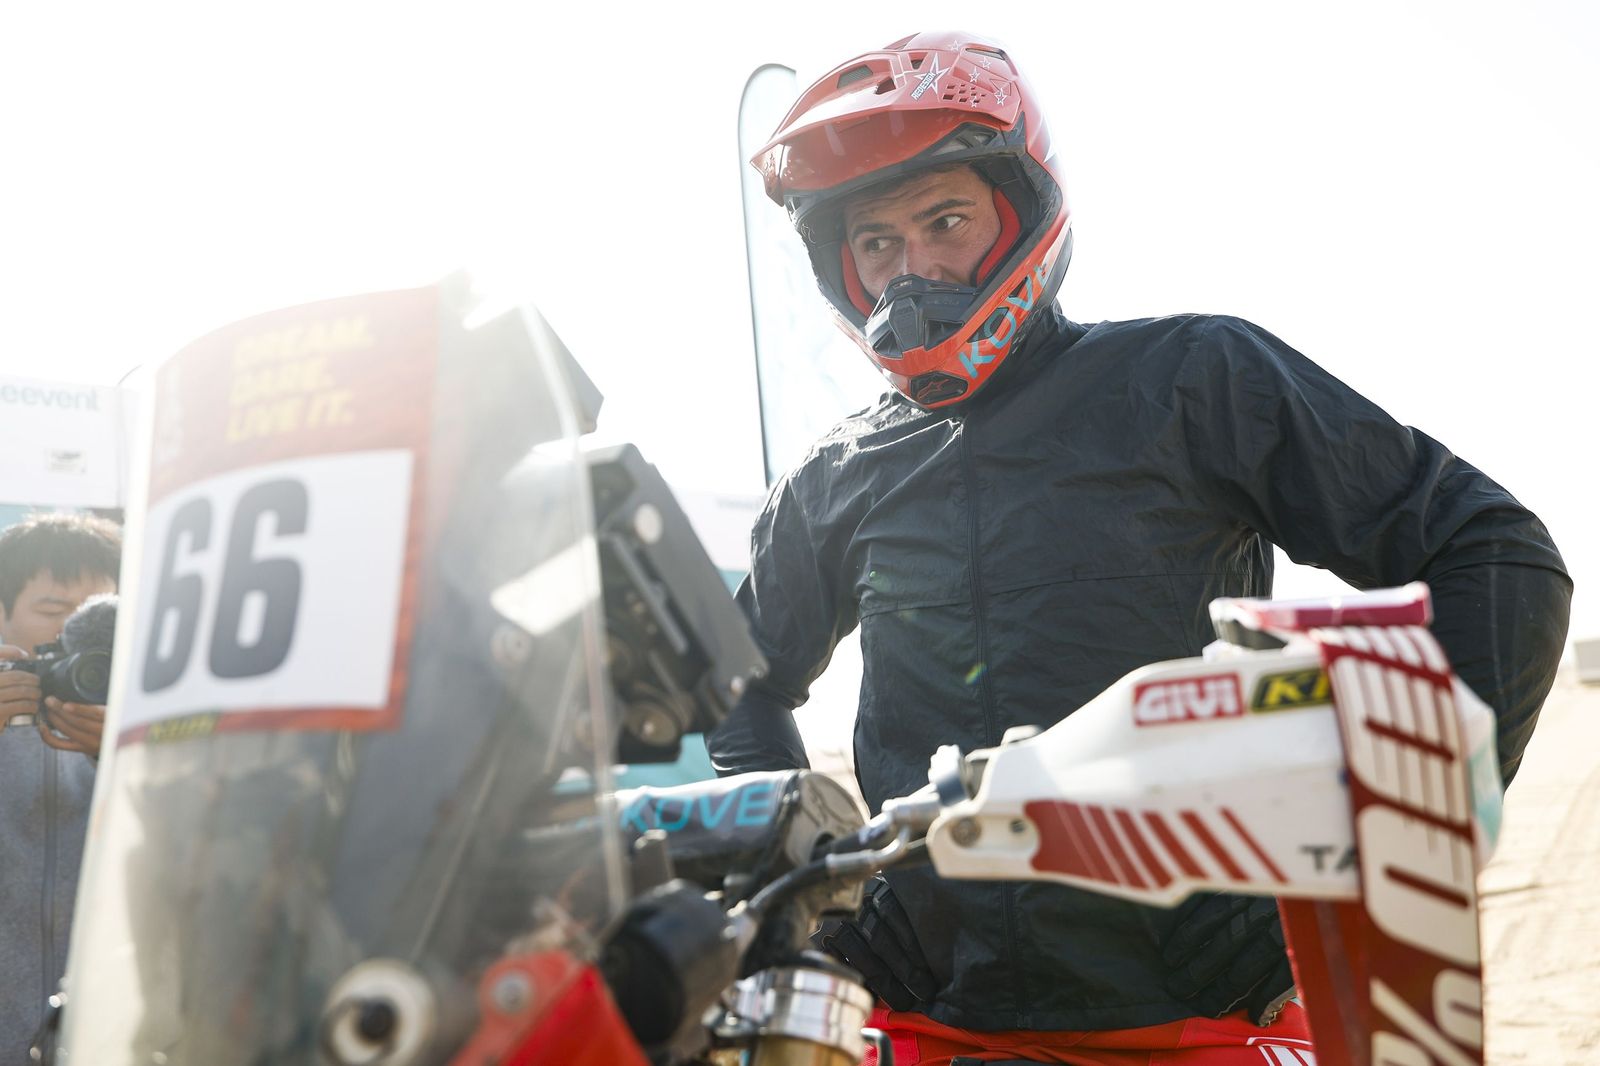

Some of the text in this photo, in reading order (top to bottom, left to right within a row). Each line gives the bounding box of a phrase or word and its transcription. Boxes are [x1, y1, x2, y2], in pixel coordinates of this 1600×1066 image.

[141, 477, 308, 694] 66
[1138, 679, 1238, 719] GIVI
[621, 783, 774, 833] KOVE
